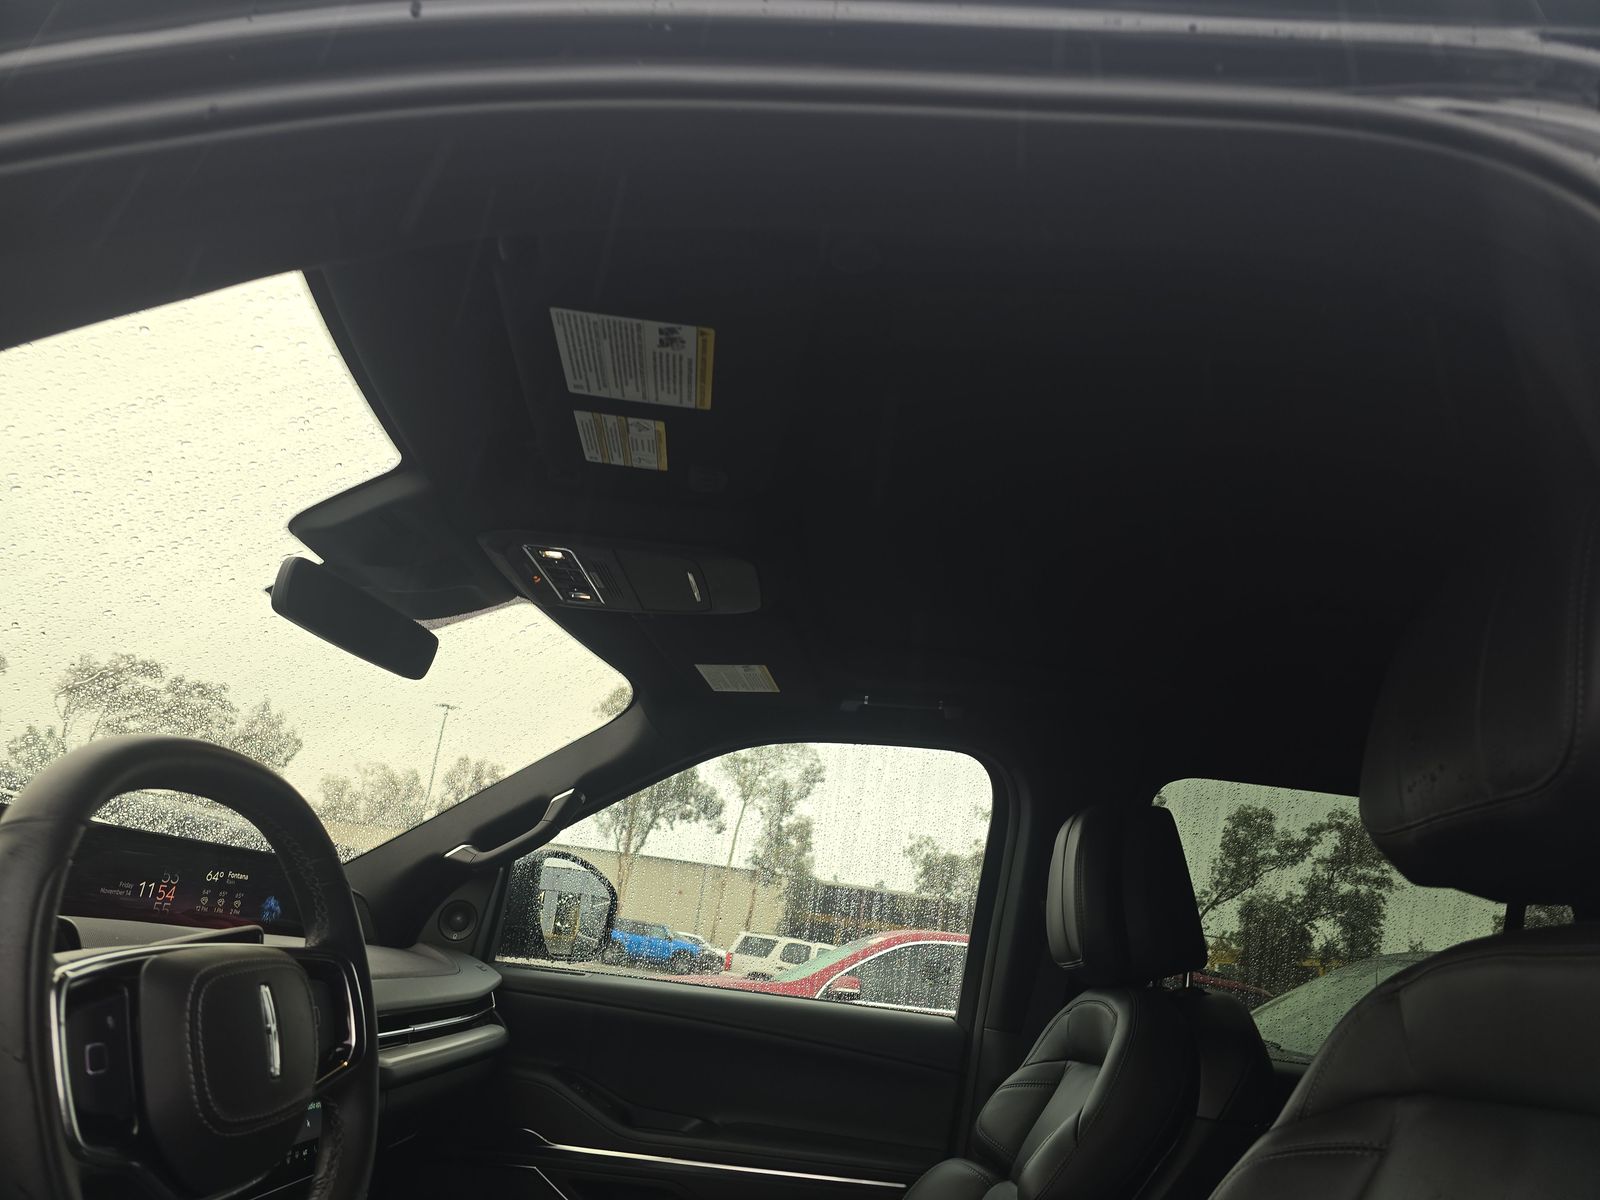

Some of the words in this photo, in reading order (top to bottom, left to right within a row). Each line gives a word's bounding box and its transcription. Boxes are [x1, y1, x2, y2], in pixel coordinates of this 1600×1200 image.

[228, 871, 249, 880] Fontana
[139, 881, 156, 898] 11
[156, 884, 177, 902] 54
